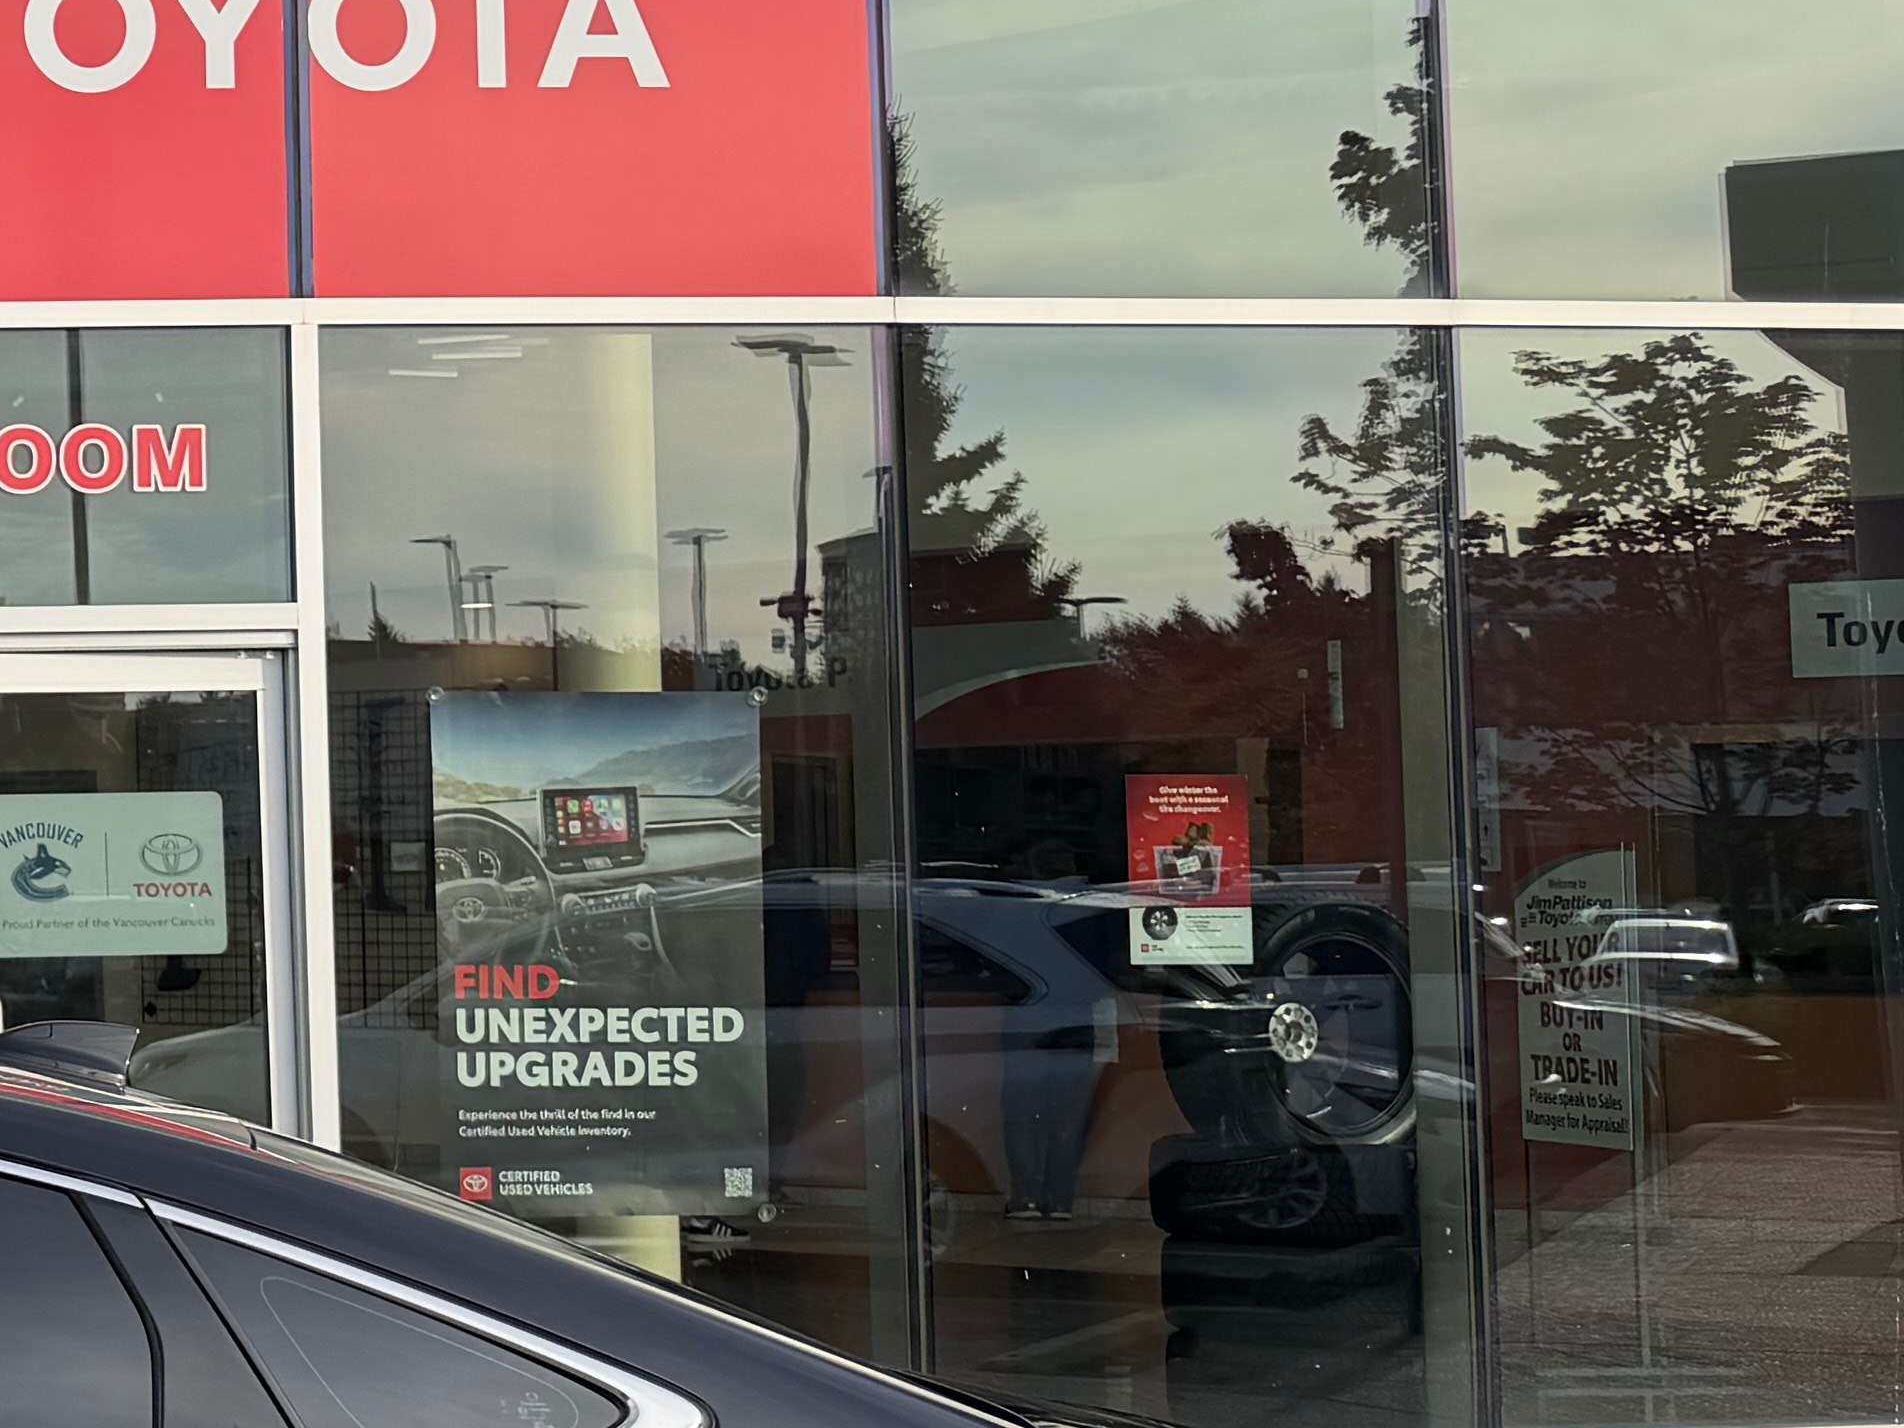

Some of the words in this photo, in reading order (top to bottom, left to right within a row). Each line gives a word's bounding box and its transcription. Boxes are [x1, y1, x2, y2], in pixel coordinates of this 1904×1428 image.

[1816, 611, 1904, 655] Toy
[133, 882, 212, 898] TOYOTA
[2, 918, 34, 931] Proud
[36, 918, 74, 930] Partner
[77, 917, 91, 929] of
[92, 917, 110, 929] the
[112, 917, 168, 929] Vancouver
[170, 916, 215, 928] Canucks
[454, 963, 561, 1000] FIND
[1562, 966, 1588, 992] TO
[1591, 963, 1622, 991] US!
[454, 1006, 745, 1044] UNEXPECTED
[1540, 1002, 1604, 1031] BUY-IN
[1562, 1032, 1582, 1052] OR
[456, 1050, 699, 1087] UPGRADES
[1530, 1054, 1618, 1086] TRADE-IN
[1529, 1087, 1558, 1106] Please
[1559, 1091, 1586, 1110] speak
[1587, 1093, 1598, 1109] to
[1599, 1092, 1623, 1111] Sales
[459, 1109, 518, 1123] Experience
[519, 1109, 538, 1121] the
[539, 1108, 566, 1121] thrill
[567, 1108, 580, 1121] of
[581, 1108, 600, 1120] the
[601, 1108, 623, 1120] find
[624, 1108, 635, 1120] in
[637, 1110, 657, 1120] our
[1525, 1109, 1566, 1132] Manager
[458, 1125, 506, 1137] Certified
[508, 1125, 535, 1137] Used
[537, 1125, 577, 1137] Vehicle
[498, 1170, 561, 1183] CERTIFIED
[499, 1183, 535, 1196] USED
[536, 1182, 593, 1196] VEHICLES
